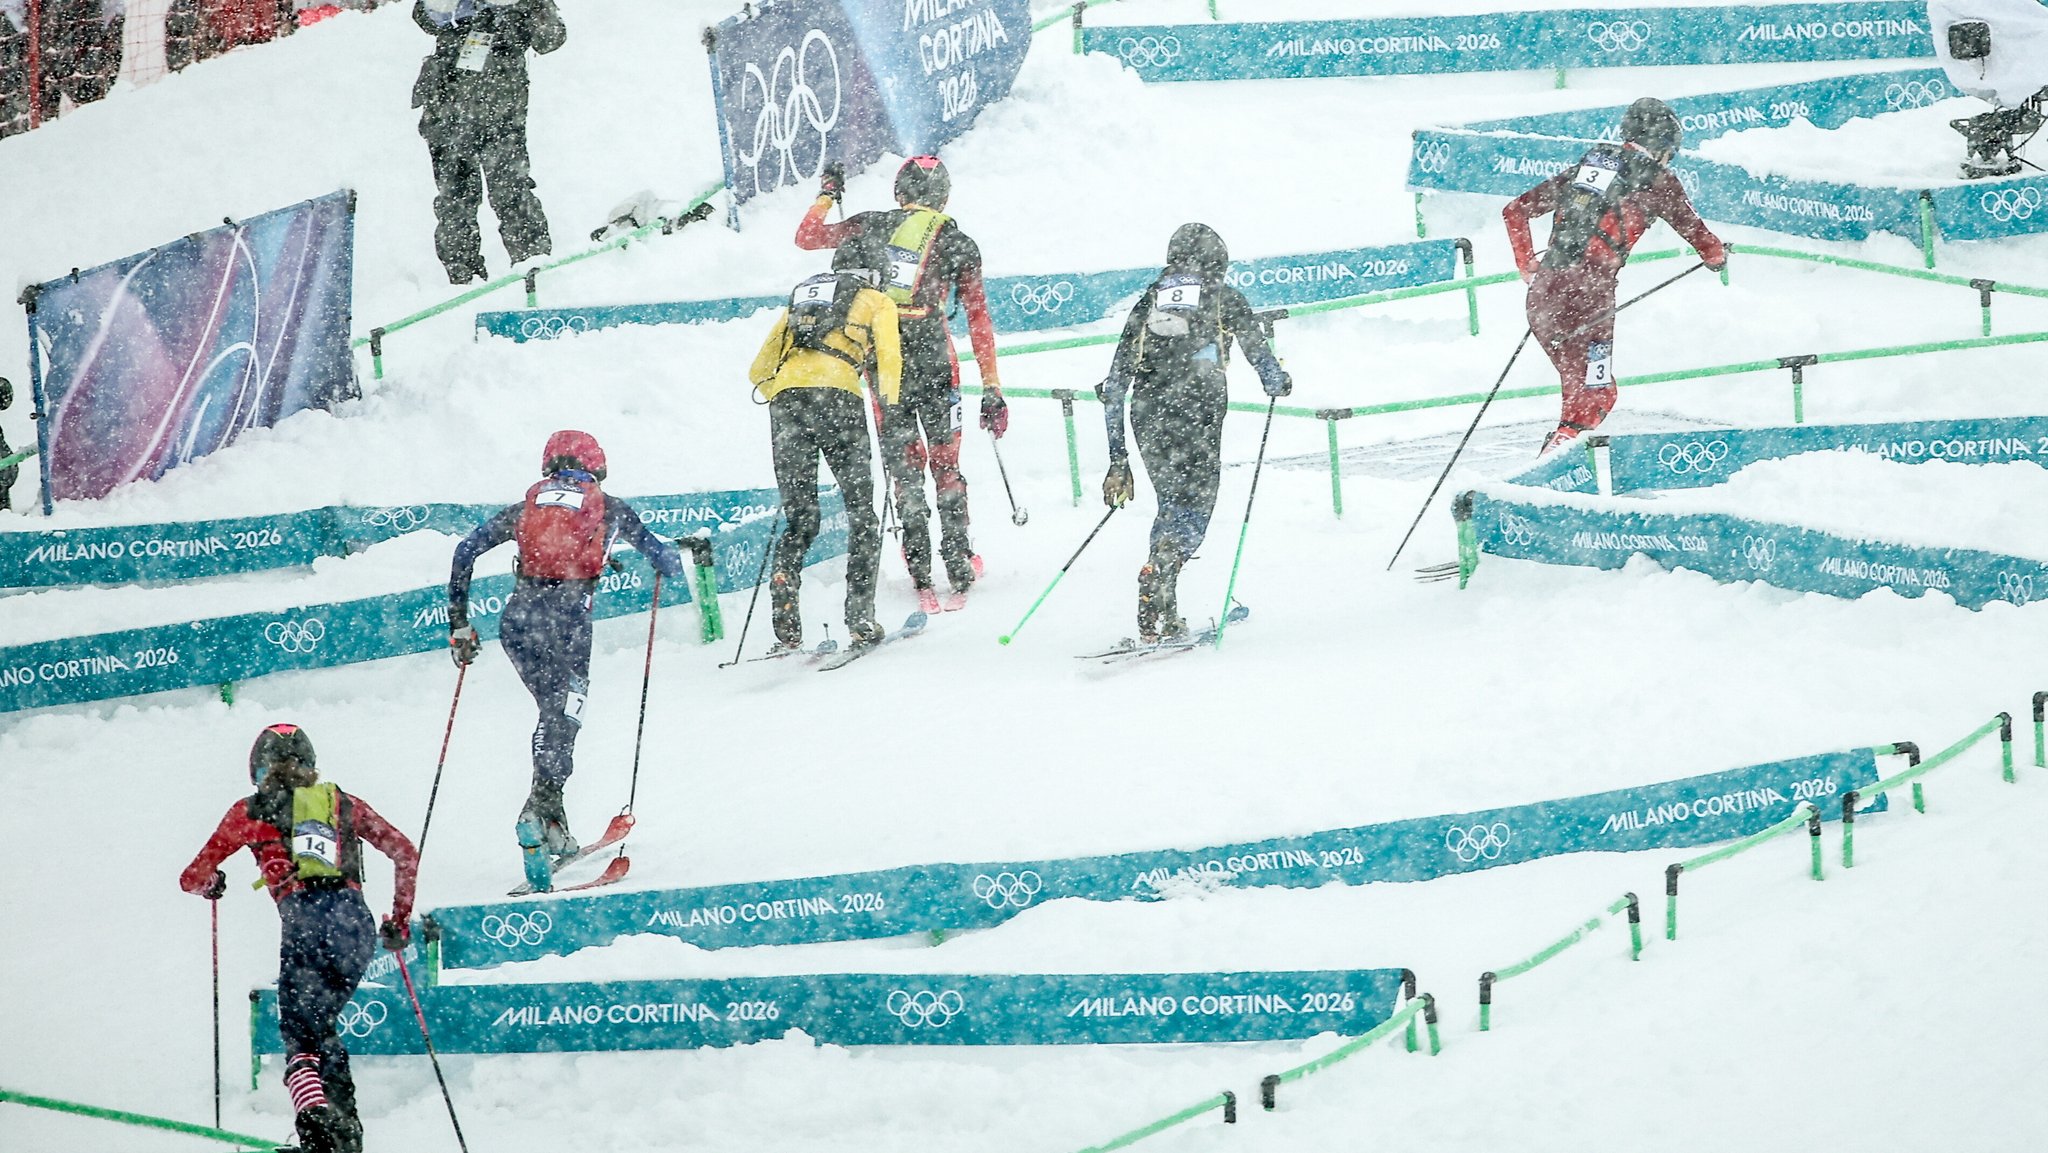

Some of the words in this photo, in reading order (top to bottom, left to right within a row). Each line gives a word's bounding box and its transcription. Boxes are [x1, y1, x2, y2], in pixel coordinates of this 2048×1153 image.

[919, 8, 1009, 76] CORTINA
[1736, 23, 1828, 42] MILANO
[1832, 20, 1926, 39] CORTINA
[1266, 38, 1356, 57] MILANO
[1358, 36, 1451, 54] CORTINA
[1455, 33, 1502, 51] 2026
[938, 67, 978, 122] 2026
[1680, 106, 1767, 133] CORTINA
[1769, 100, 1809, 120] 2026
[1492, 155, 1544, 177] MILANO
[1586, 170, 1599, 184] 3
[1741, 191, 1790, 212] MILANO
[1789, 199, 1842, 220] CORTINA
[1842, 204, 1874, 221] 2026
[890, 264, 900, 280] 6
[1259, 263, 1358, 284] CORTINA
[1361, 258, 1408, 278] 2026
[808, 286, 820, 299] 5
[1171, 289, 1184, 302] 8
[1596, 364, 1605, 380] 3
[1930, 438, 2032, 458] CORTINA
[554, 492, 566, 502] 7
[638, 506, 724, 525] ORTINA
[25, 541, 125, 563] MILANO
[128, 536, 230, 559] CORTINA
[231, 527, 283, 551] 2026
[1572, 532, 1620, 550] MILANO
[1621, 533, 1678, 552] CORTINA
[1677, 535, 1708, 551] 2026
[1820, 556, 1868, 580] MILANO
[1869, 563, 1921, 586] CORTINA
[1922, 569, 1950, 588] 2026
[412, 595, 502, 629] MILNO
[600, 570, 642, 593] 2026
[0, 666, 35, 688] NO
[38, 655, 130, 681] CORTINA
[133, 646, 179, 669] 2026
[576, 698, 584, 715] 7
[1600, 801, 1690, 835] MILANO
[1693, 787, 1788, 817] CORTINA
[1790, 776, 1838, 800] 2026
[305, 836, 326, 855] 14
[1226, 849, 1318, 874] CORTINA
[1319, 846, 1365, 868] 2026
[647, 905, 737, 928] MILANO
[740, 897, 839, 922] CORTINA
[841, 891, 886, 914] 2026
[492, 1005, 603, 1026] MILANO
[606, 1003, 720, 1023] CORTINA
[726, 1001, 780, 1022] 2026
[1067, 996, 1178, 1017] MILANO
[1181, 994, 1297, 1015] CORTINA
[1300, 991, 1356, 1013] 2026
